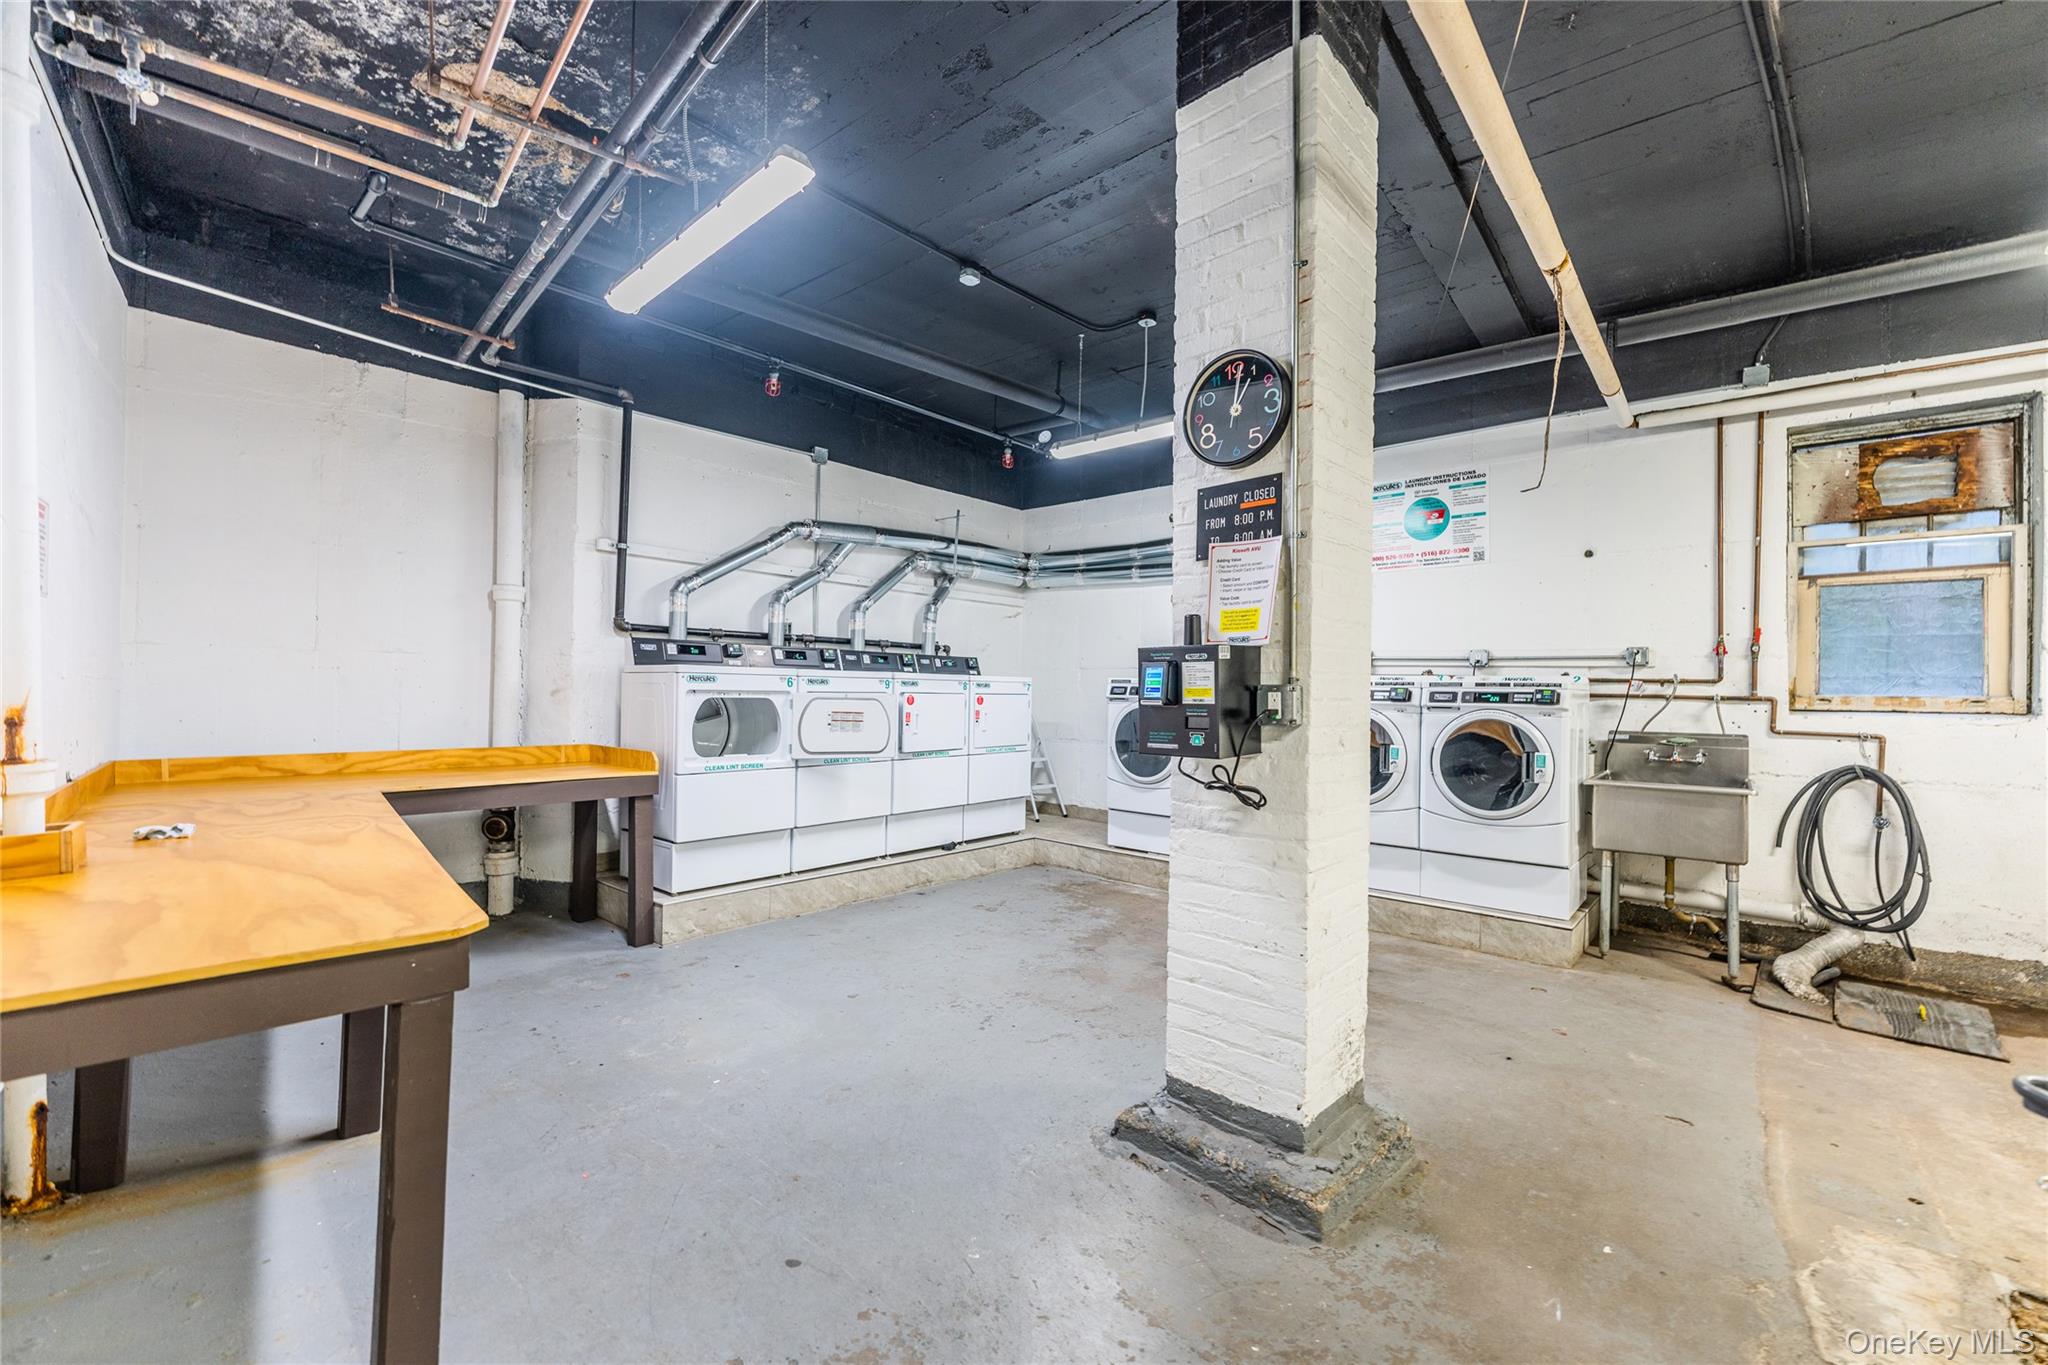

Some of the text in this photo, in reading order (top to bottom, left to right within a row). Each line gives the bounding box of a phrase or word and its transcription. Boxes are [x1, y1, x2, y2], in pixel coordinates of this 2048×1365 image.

[1225, 361, 1244, 380] 12
[1250, 364, 1256, 376] 1
[1264, 374, 1273, 387] 2
[1198, 392, 1216, 408] 10
[1264, 388, 1280, 413] 3
[1195, 414, 1204, 426] 9
[1200, 423, 1216, 449] 8
[1248, 426, 1263, 449] 5
[1214, 440, 1223, 456] 7
[1232, 446, 1240, 456] 6
[1404, 478, 1451, 488] INSTRUCCIONES
[1462, 472, 1486, 480] LAVADO
[1432, 470, 1476, 480] INSTRUCTIONS
[1204, 486, 1276, 510] LAUNDRY CLOSED
[1206, 509, 1274, 530] FROM 8:00 P.M.
[1234, 532, 1254, 542] 8:00
[786, 677, 794, 688] 6
[884, 680, 890, 689] 9
[962, 682, 968, 690] 8
